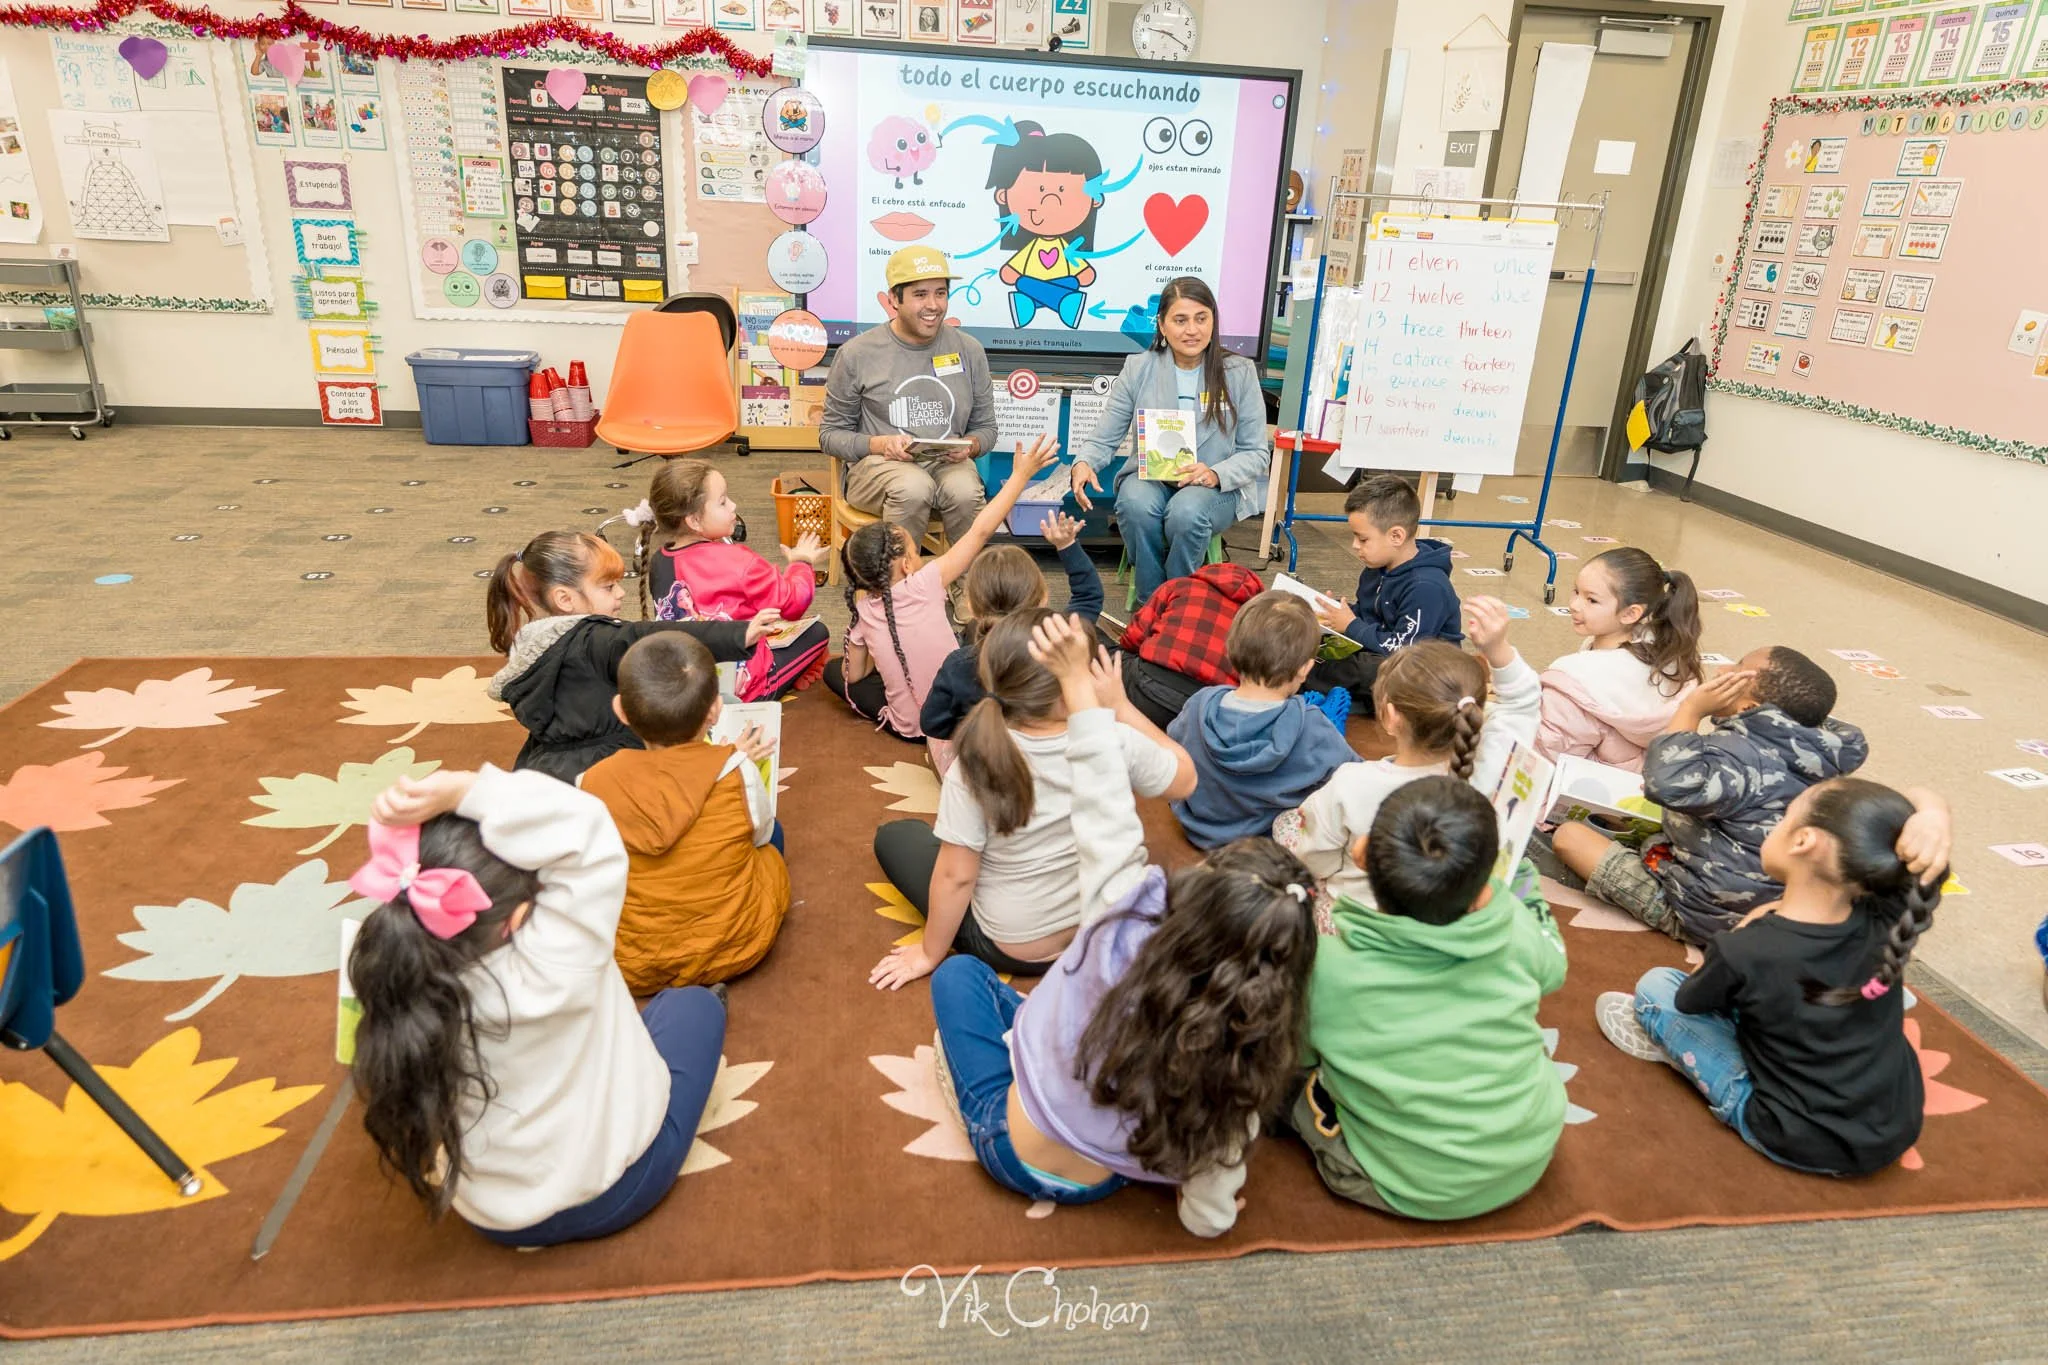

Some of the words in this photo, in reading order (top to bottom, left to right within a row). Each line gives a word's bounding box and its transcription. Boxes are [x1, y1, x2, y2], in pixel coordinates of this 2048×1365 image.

[1153, 5, 1159, 13] 11
[1164, 2, 1171, 10] 12
[1143, 14, 1150, 22] 10
[1996, 8, 2019, 18] quince
[1184, 17, 1189, 26] 2
[1941, 15, 1967, 24] catorce
[1855, 26, 1870, 34] doce
[1899, 22, 1915, 30] trece
[1186, 30, 1192, 39] 3
[1992, 21, 2013, 43] 15
[1894, 33, 1911, 53] 13
[1940, 27, 1960, 49] 14
[1811, 42, 1826, 60] 11
[1851, 38, 1868, 58] 12
[1150, 50, 1155, 60] 7
[1173, 52, 1178, 60] 5
[900, 63, 951, 87] todo
[961, 67, 980, 88] el
[989, 73, 1065, 100] cuerpo
[1073, 79, 1200, 104] escuchando
[600, 85, 628, 97] Clima
[738, 86, 750, 95] de
[752, 88, 769, 96] voz
[536, 93, 543, 103] 6
[1450, 142, 1475, 154] EXIT
[543, 166, 552, 174] 10
[625, 170, 634, 178] 14
[1148, 164, 1164, 172] ojos
[1190, 166, 1222, 174] mirando
[604, 188, 614, 196] 20
[872, 196, 880, 204] El
[882, 198, 904, 206] cebro
[907, 199, 926, 207] está
[929, 200, 966, 208] enfocado
[869, 248, 892, 256] labios
[914, 256, 928, 264] DO
[1377, 248, 1392, 272] 11
[1408, 249, 1460, 272] elven
[1766, 264, 1777, 282] 6
[1372, 282, 1392, 302] 12
[1408, 282, 1465, 306] twelve
[745, 316, 756, 325] NO
[1368, 310, 1386, 329] 13
[1400, 314, 1445, 338] trece
[1458, 321, 1512, 339] thirteen
[1044, 339, 1082, 348] tranquilos
[1364, 337, 1378, 355] 14
[330, 390, 366, 398] Contactar
[1356, 385, 1374, 404] 16
[908, 401, 942, 411] LEADERS
[908, 410, 944, 418] READERS
[910, 416, 950, 428] NETWORK
[1354, 416, 1372, 434] 17
[2003, 773, 2040, 782] ha
